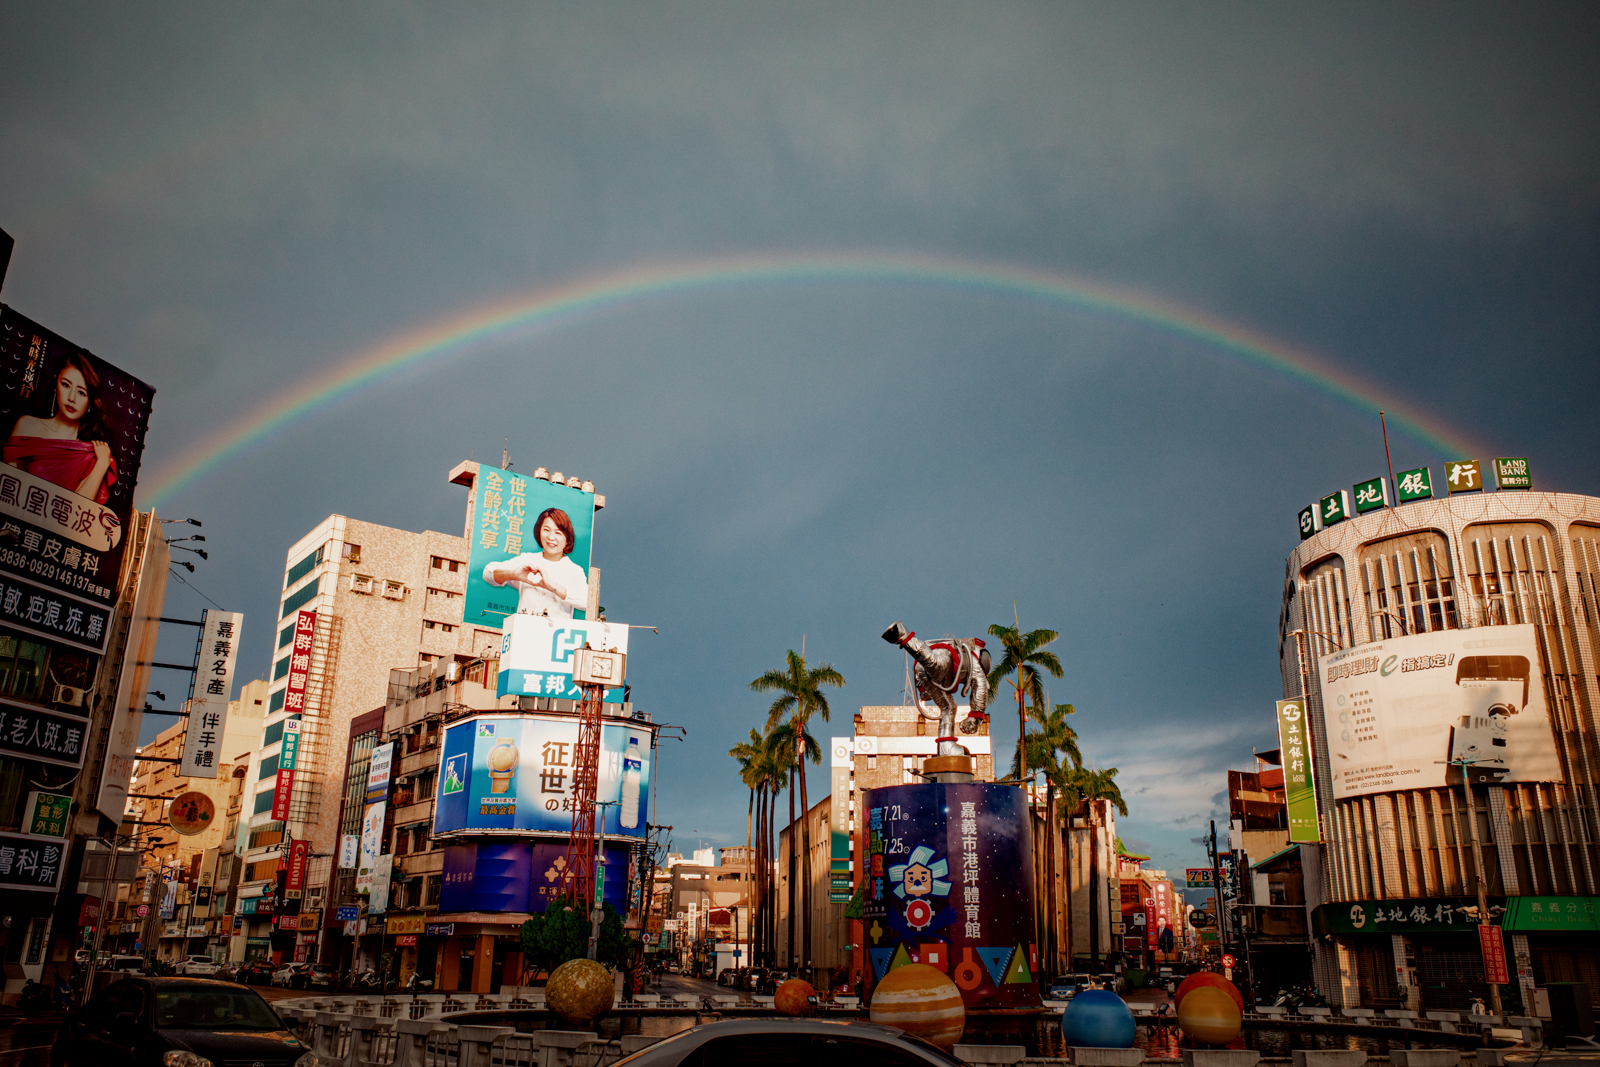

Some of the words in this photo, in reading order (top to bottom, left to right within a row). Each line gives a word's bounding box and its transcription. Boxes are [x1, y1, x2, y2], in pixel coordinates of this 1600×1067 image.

[1325, 464, 1477, 518] 土地銀行
[1501, 477, 1529, 485] 嘉義分行
[0, 473, 96, 537] 鳳凰電波
[480, 472, 504, 549] 全齡共享
[504, 477, 527, 555] 世代宜居
[0, 546, 90, 590] 3836·0929145137
[207, 621, 235, 695] 嘉義名產
[286, 615, 313, 709] 弘群補習班
[1327, 656, 1379, 683] 即時理財
[1401, 653, 1455, 673] 指搞定!
[195, 712, 220, 768] 伴手禮
[283, 734, 295, 768] 聯邦銀行
[1288, 725, 1304, 772] 土地銀行
[1364, 769, 1420, 780] www.landbank.com.tw
[38, 804, 64, 820] 整形
[480, 805, 517, 815] 最高金賞
[883, 805, 901, 822] 7.21
[35, 820, 61, 836] 外科
[883, 838, 903, 855] 7.25
[38, 845, 60, 884] 診所
[291, 843, 305, 886] Canon
[961, 802, 981, 938] 嘉義市港坪體育館
[282, 918, 298, 928] 照相
[1373, 904, 1454, 925] 土地銀行
[1531, 902, 1594, 913] 嘉義分行
[1532, 915, 1560, 923] Chiayi
